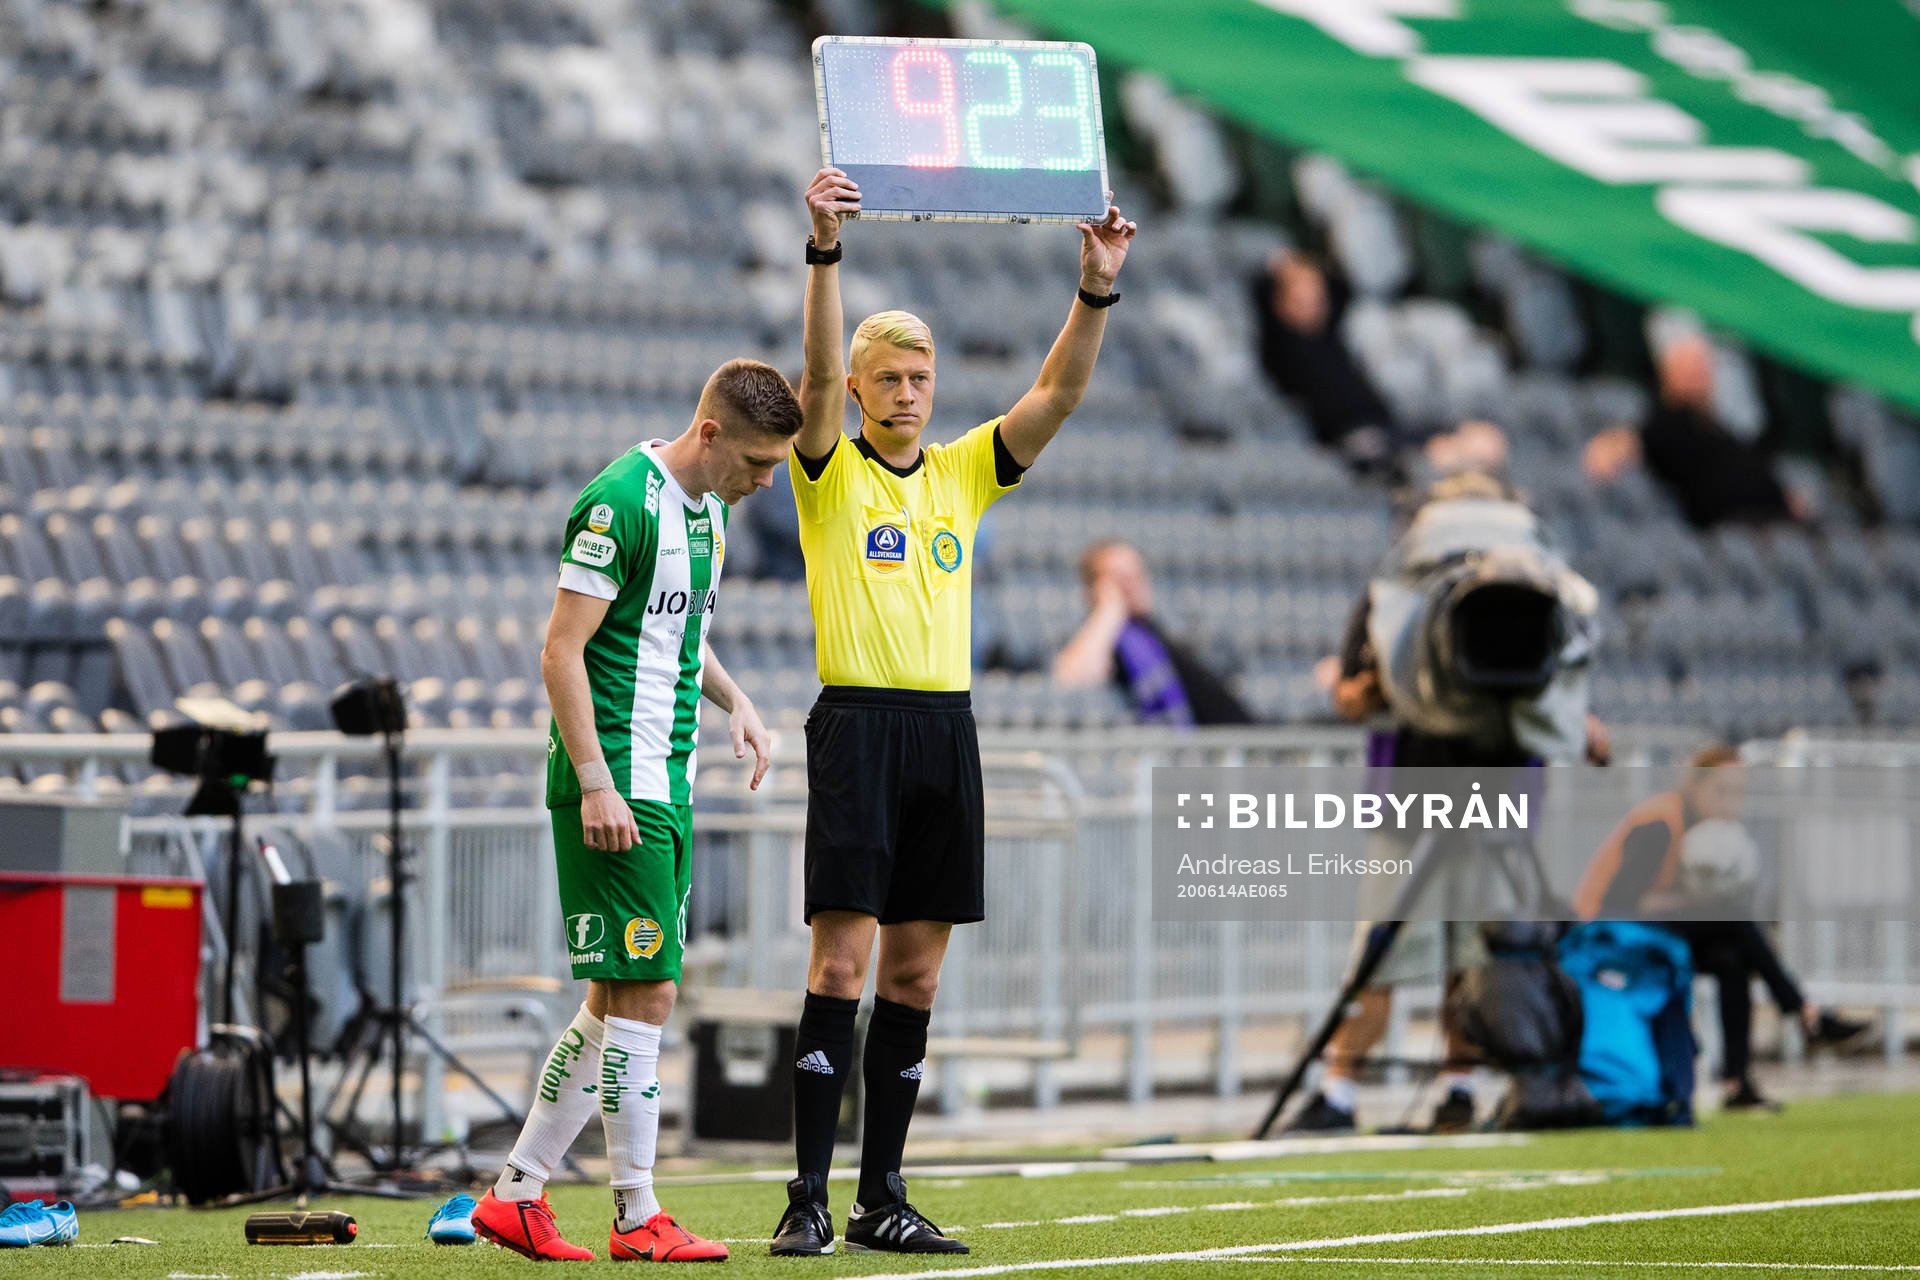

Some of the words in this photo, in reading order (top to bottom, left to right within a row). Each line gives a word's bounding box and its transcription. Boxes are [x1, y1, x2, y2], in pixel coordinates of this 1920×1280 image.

[893, 48, 958, 168] 9
[964, 50, 1094, 172] 23
[577, 537, 612, 555] UNIBET
[660, 547, 681, 557] CRAFT
[868, 550, 902, 559] ALLSVENSKAN
[540, 1027, 585, 1104] Clinton
[796, 1060, 834, 1075] adidas
[602, 1047, 629, 1114] Clinton
